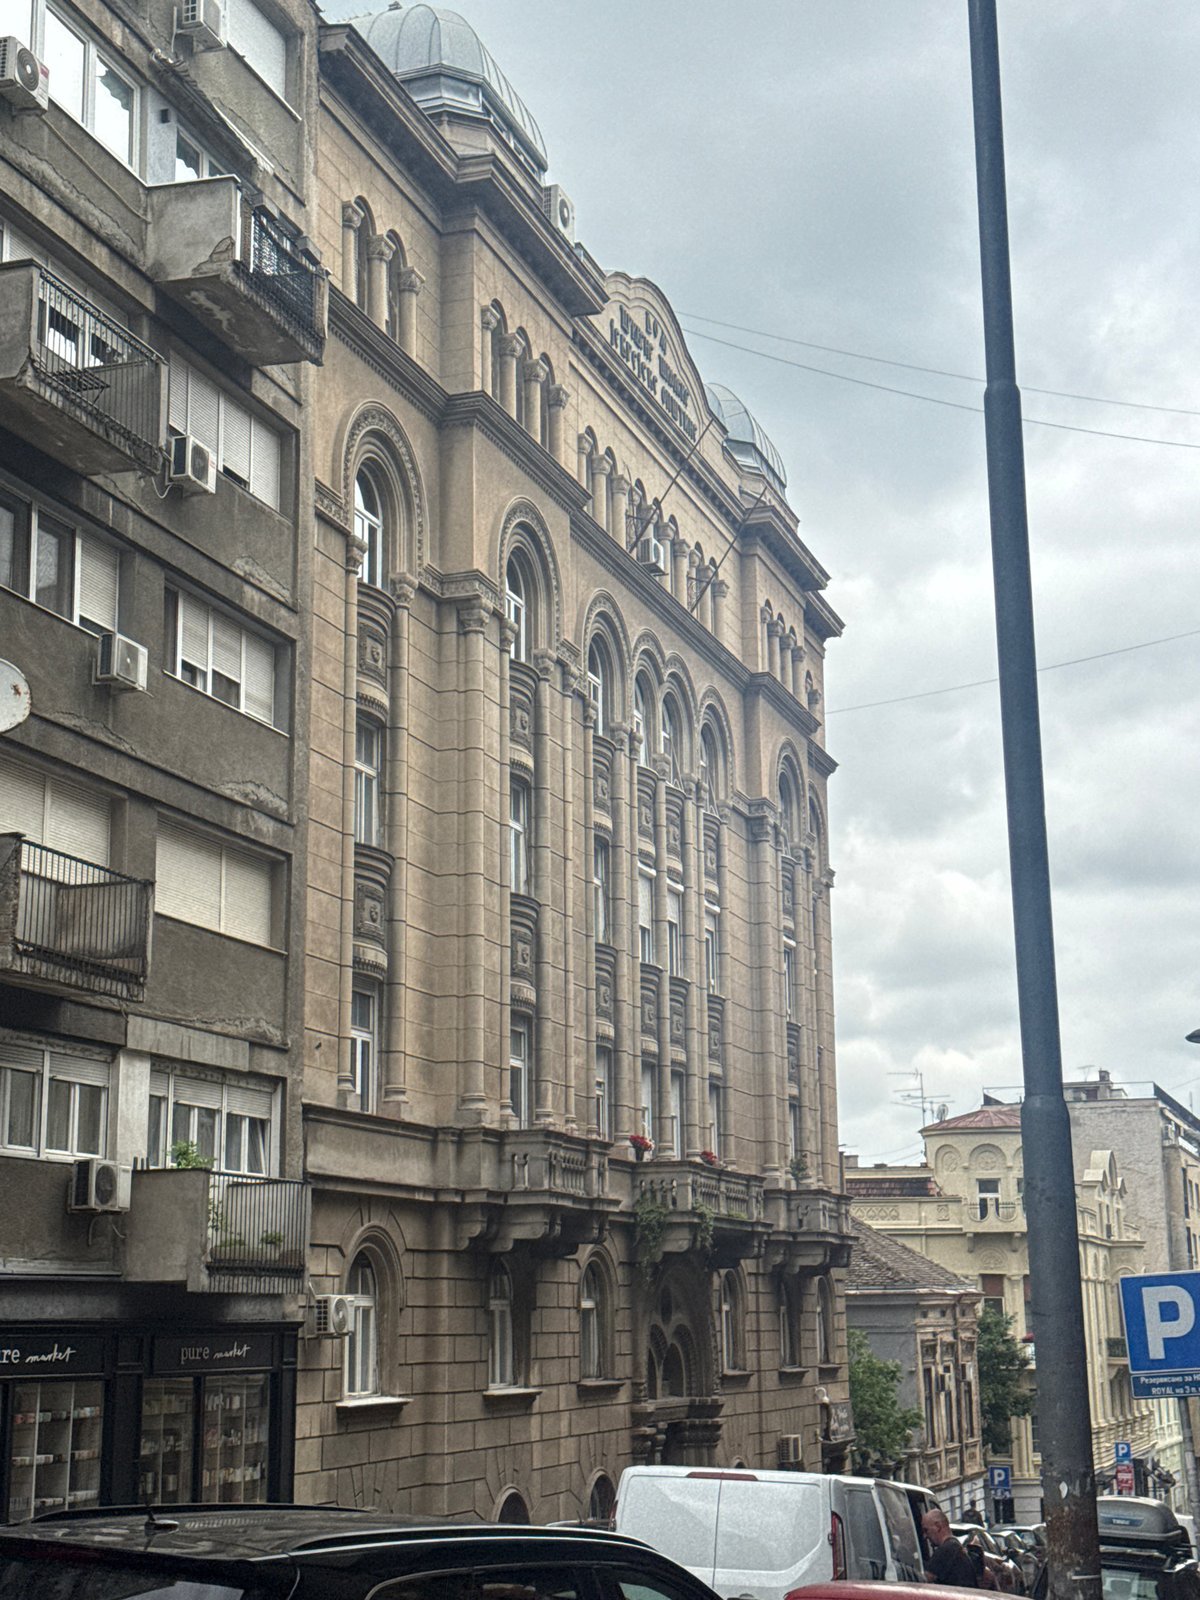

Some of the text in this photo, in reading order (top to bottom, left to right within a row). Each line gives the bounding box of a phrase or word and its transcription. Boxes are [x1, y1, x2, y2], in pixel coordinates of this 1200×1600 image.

[1141, 1285, 1196, 1360] P
[25, 1343, 77, 1364] market
[180, 1341, 251, 1365] pure market
[1117, 1444, 1128, 1456] P
[993, 1469, 1006, 1485] P
